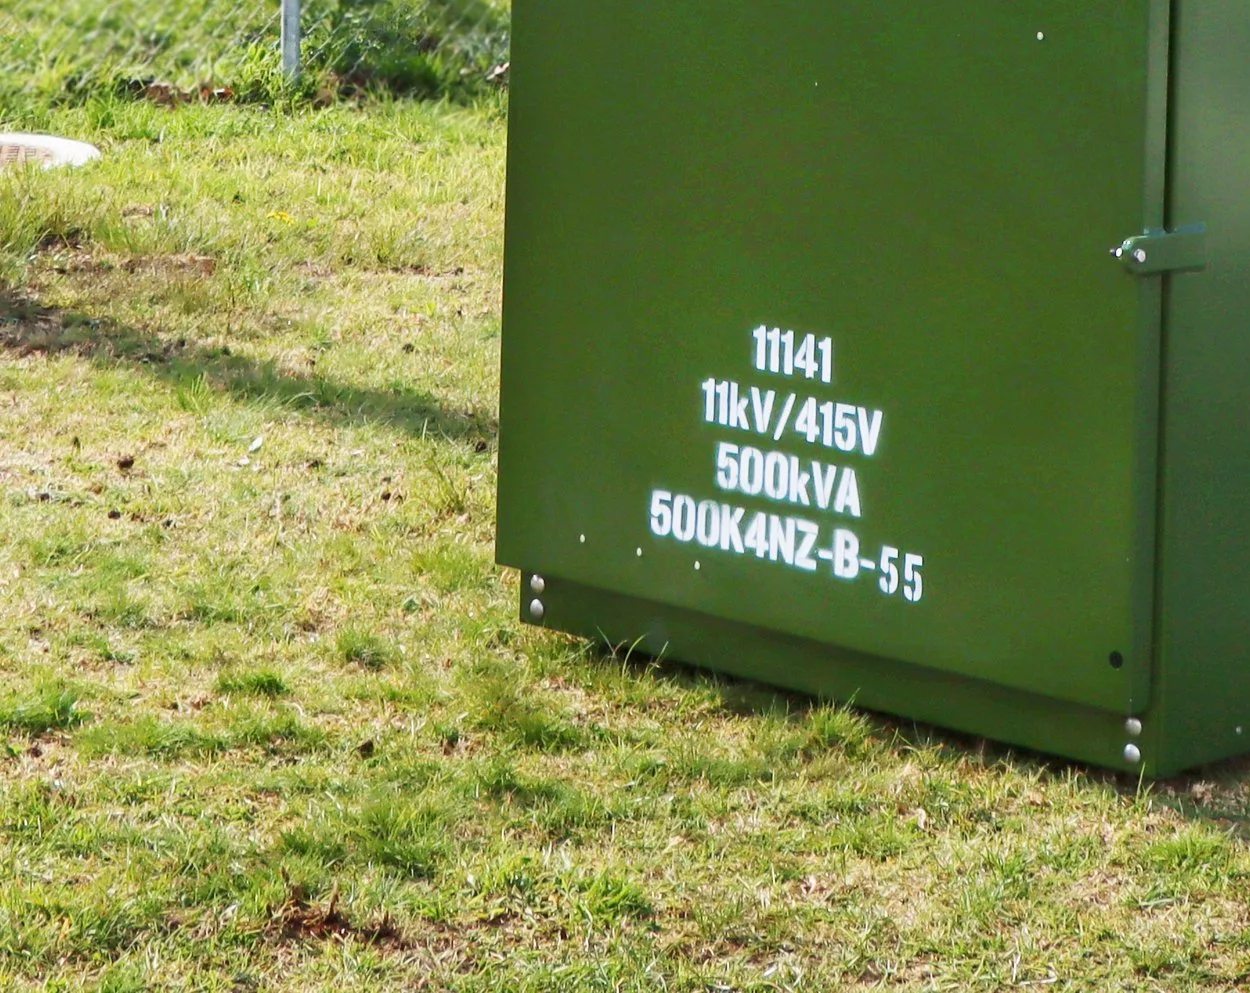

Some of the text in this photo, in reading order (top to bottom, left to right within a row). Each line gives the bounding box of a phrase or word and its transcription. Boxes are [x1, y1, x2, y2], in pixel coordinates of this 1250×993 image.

[753, 324, 832, 384] 11141
[702, 377, 884, 456] 11kV/415V
[715, 441, 862, 518] 500kVA
[650, 489, 923, 602] 500K4NZ-B-55
